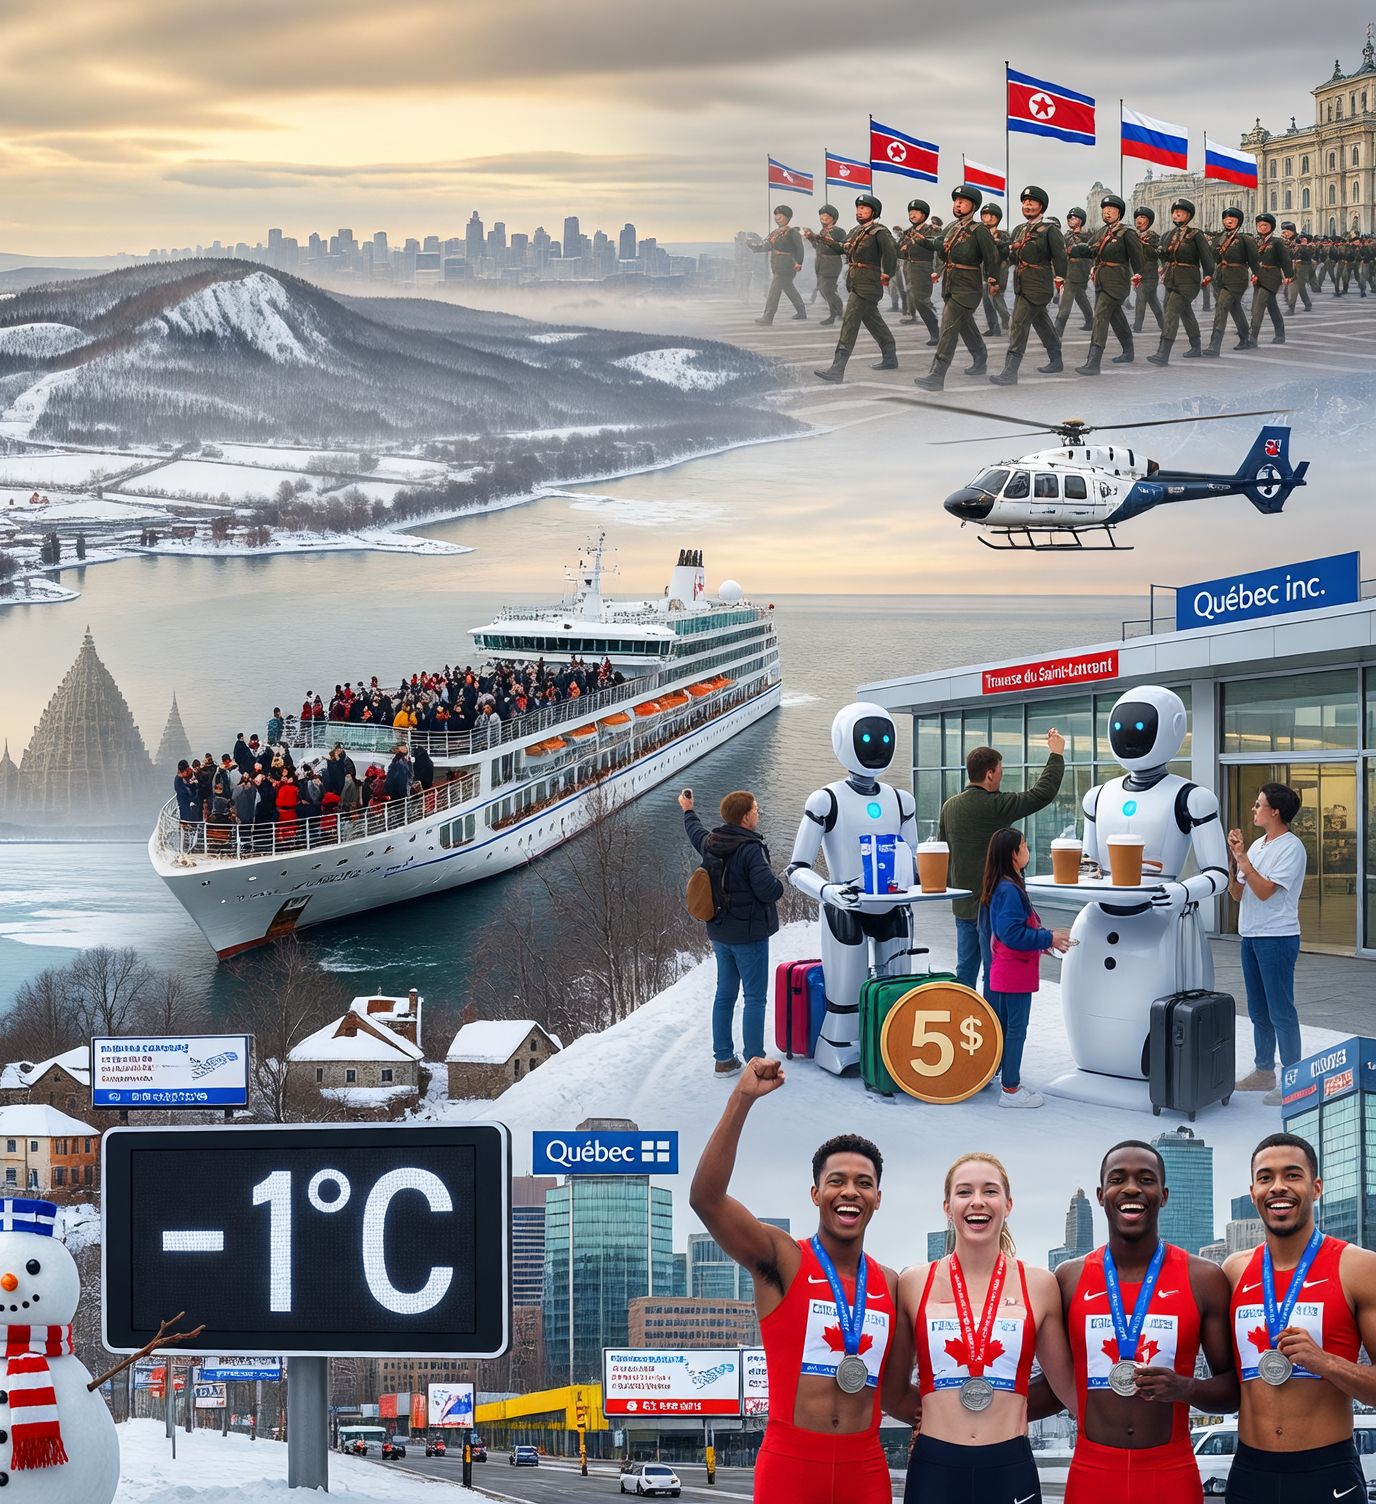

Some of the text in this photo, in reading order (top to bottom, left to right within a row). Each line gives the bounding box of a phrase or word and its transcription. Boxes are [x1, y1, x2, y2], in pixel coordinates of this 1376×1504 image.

[1193, 574, 1326, 620] Québec inc.
[1024, 669, 1037, 683] du
[546, 1139, 635, 1168] Québec
